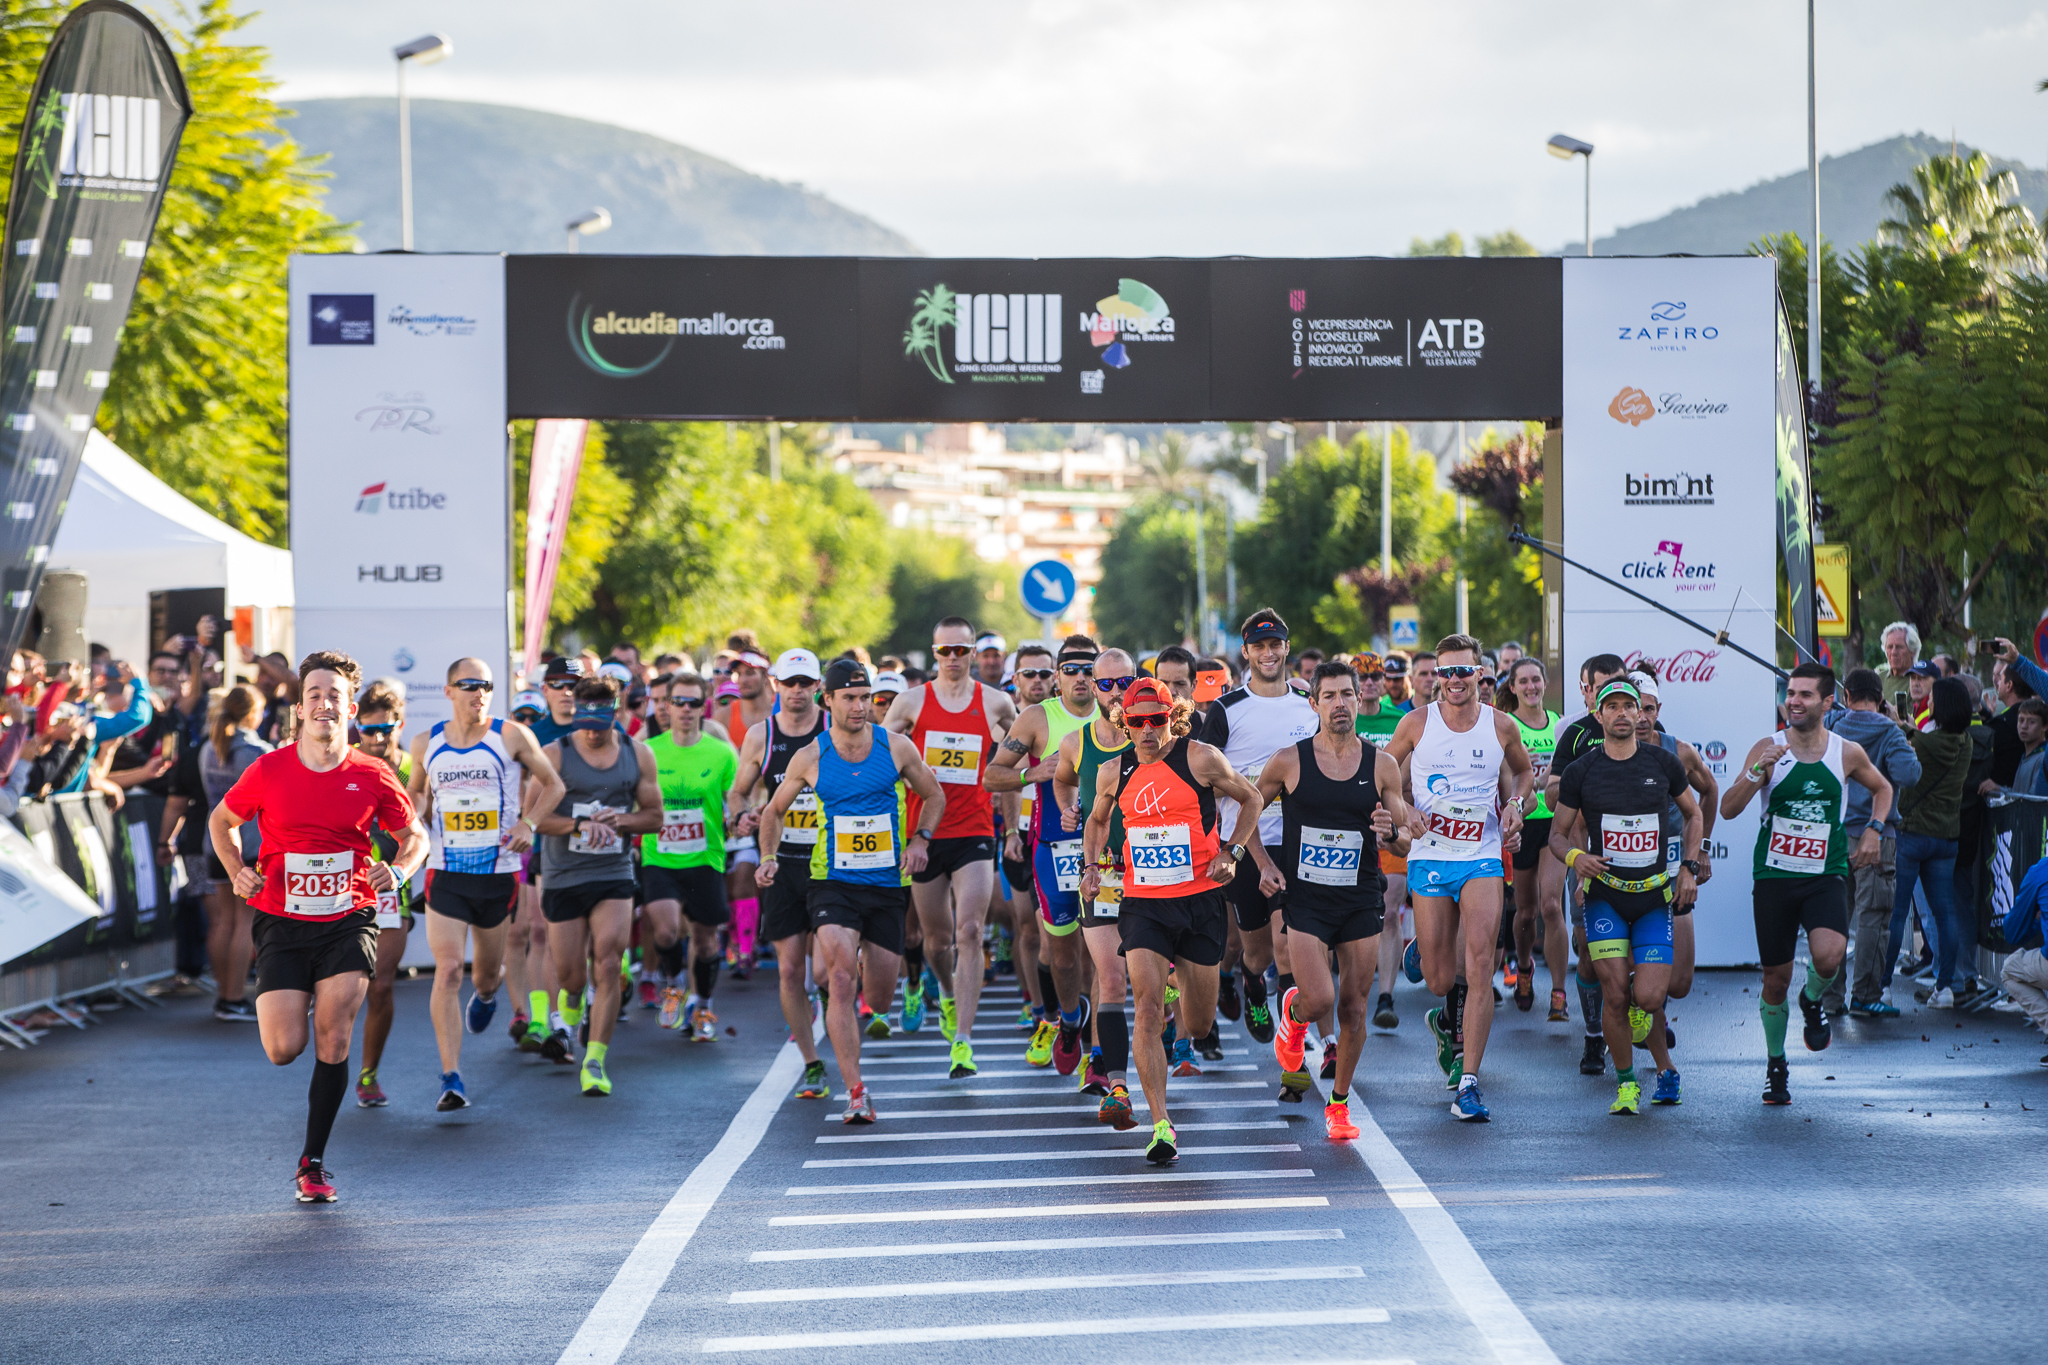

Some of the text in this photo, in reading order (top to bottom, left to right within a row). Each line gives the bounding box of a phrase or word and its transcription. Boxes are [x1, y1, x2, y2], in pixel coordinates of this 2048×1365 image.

[593, 311, 774, 335] alcudiamallorca
[1080, 312, 1175, 332] Mallorca
[1312, 332, 1380, 342] CONSELLERIA
[1418, 318, 1485, 349] ATB
[742, 336, 785, 350] .com
[1308, 356, 1354, 366] RECERCA
[1361, 356, 1403, 367] TURISME
[1657, 392, 1729, 415] Gavina
[388, 487, 446, 510] tribe
[358, 565, 443, 582] HUUB
[1622, 561, 1715, 578] Click Rent
[1675, 582, 1696, 592] your
[940, 750, 964, 767] 25
[438, 770, 489, 782] ERDINGER
[452, 813, 488, 830] 159
[787, 812, 818, 827] 172
[1432, 816, 1480, 840] 2122
[660, 825, 701, 841] 2041
[1607, 832, 1654, 851] 2005
[852, 834, 877, 852] 56
[1773, 834, 1823, 858] 2125
[1135, 847, 1186, 868] 2333
[1304, 846, 1356, 868] 2322
[290, 872, 348, 896] 2038
